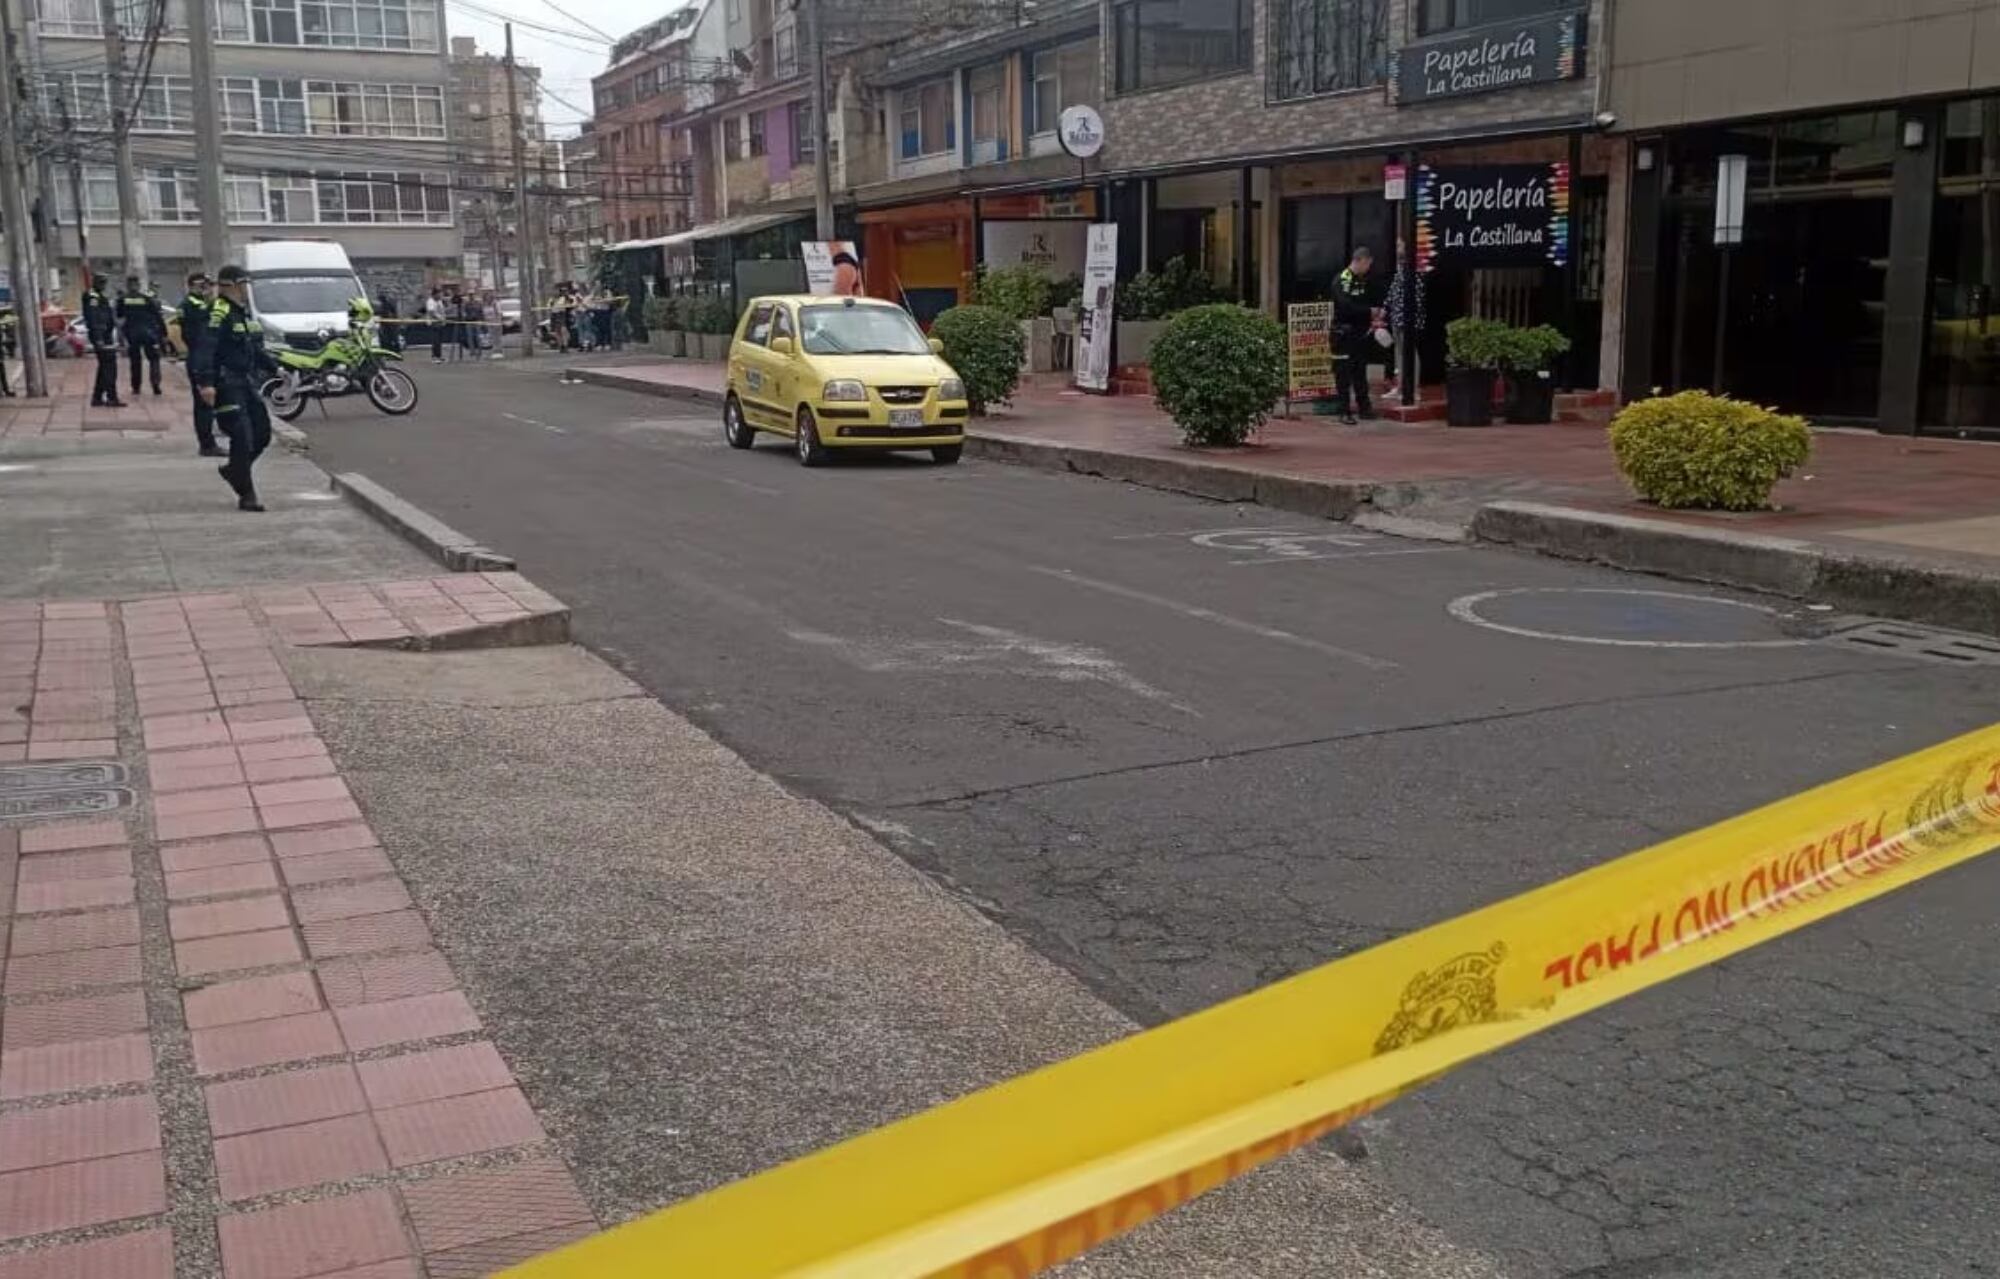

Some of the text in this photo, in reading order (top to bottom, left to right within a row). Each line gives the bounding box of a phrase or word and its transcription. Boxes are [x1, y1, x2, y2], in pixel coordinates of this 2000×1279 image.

[1423, 32, 1536, 76] Papelería
[1426, 64, 1533, 95] La Castillana
[1439, 178, 1545, 221] Papelería
[1445, 223, 1543, 247] La Castillana
